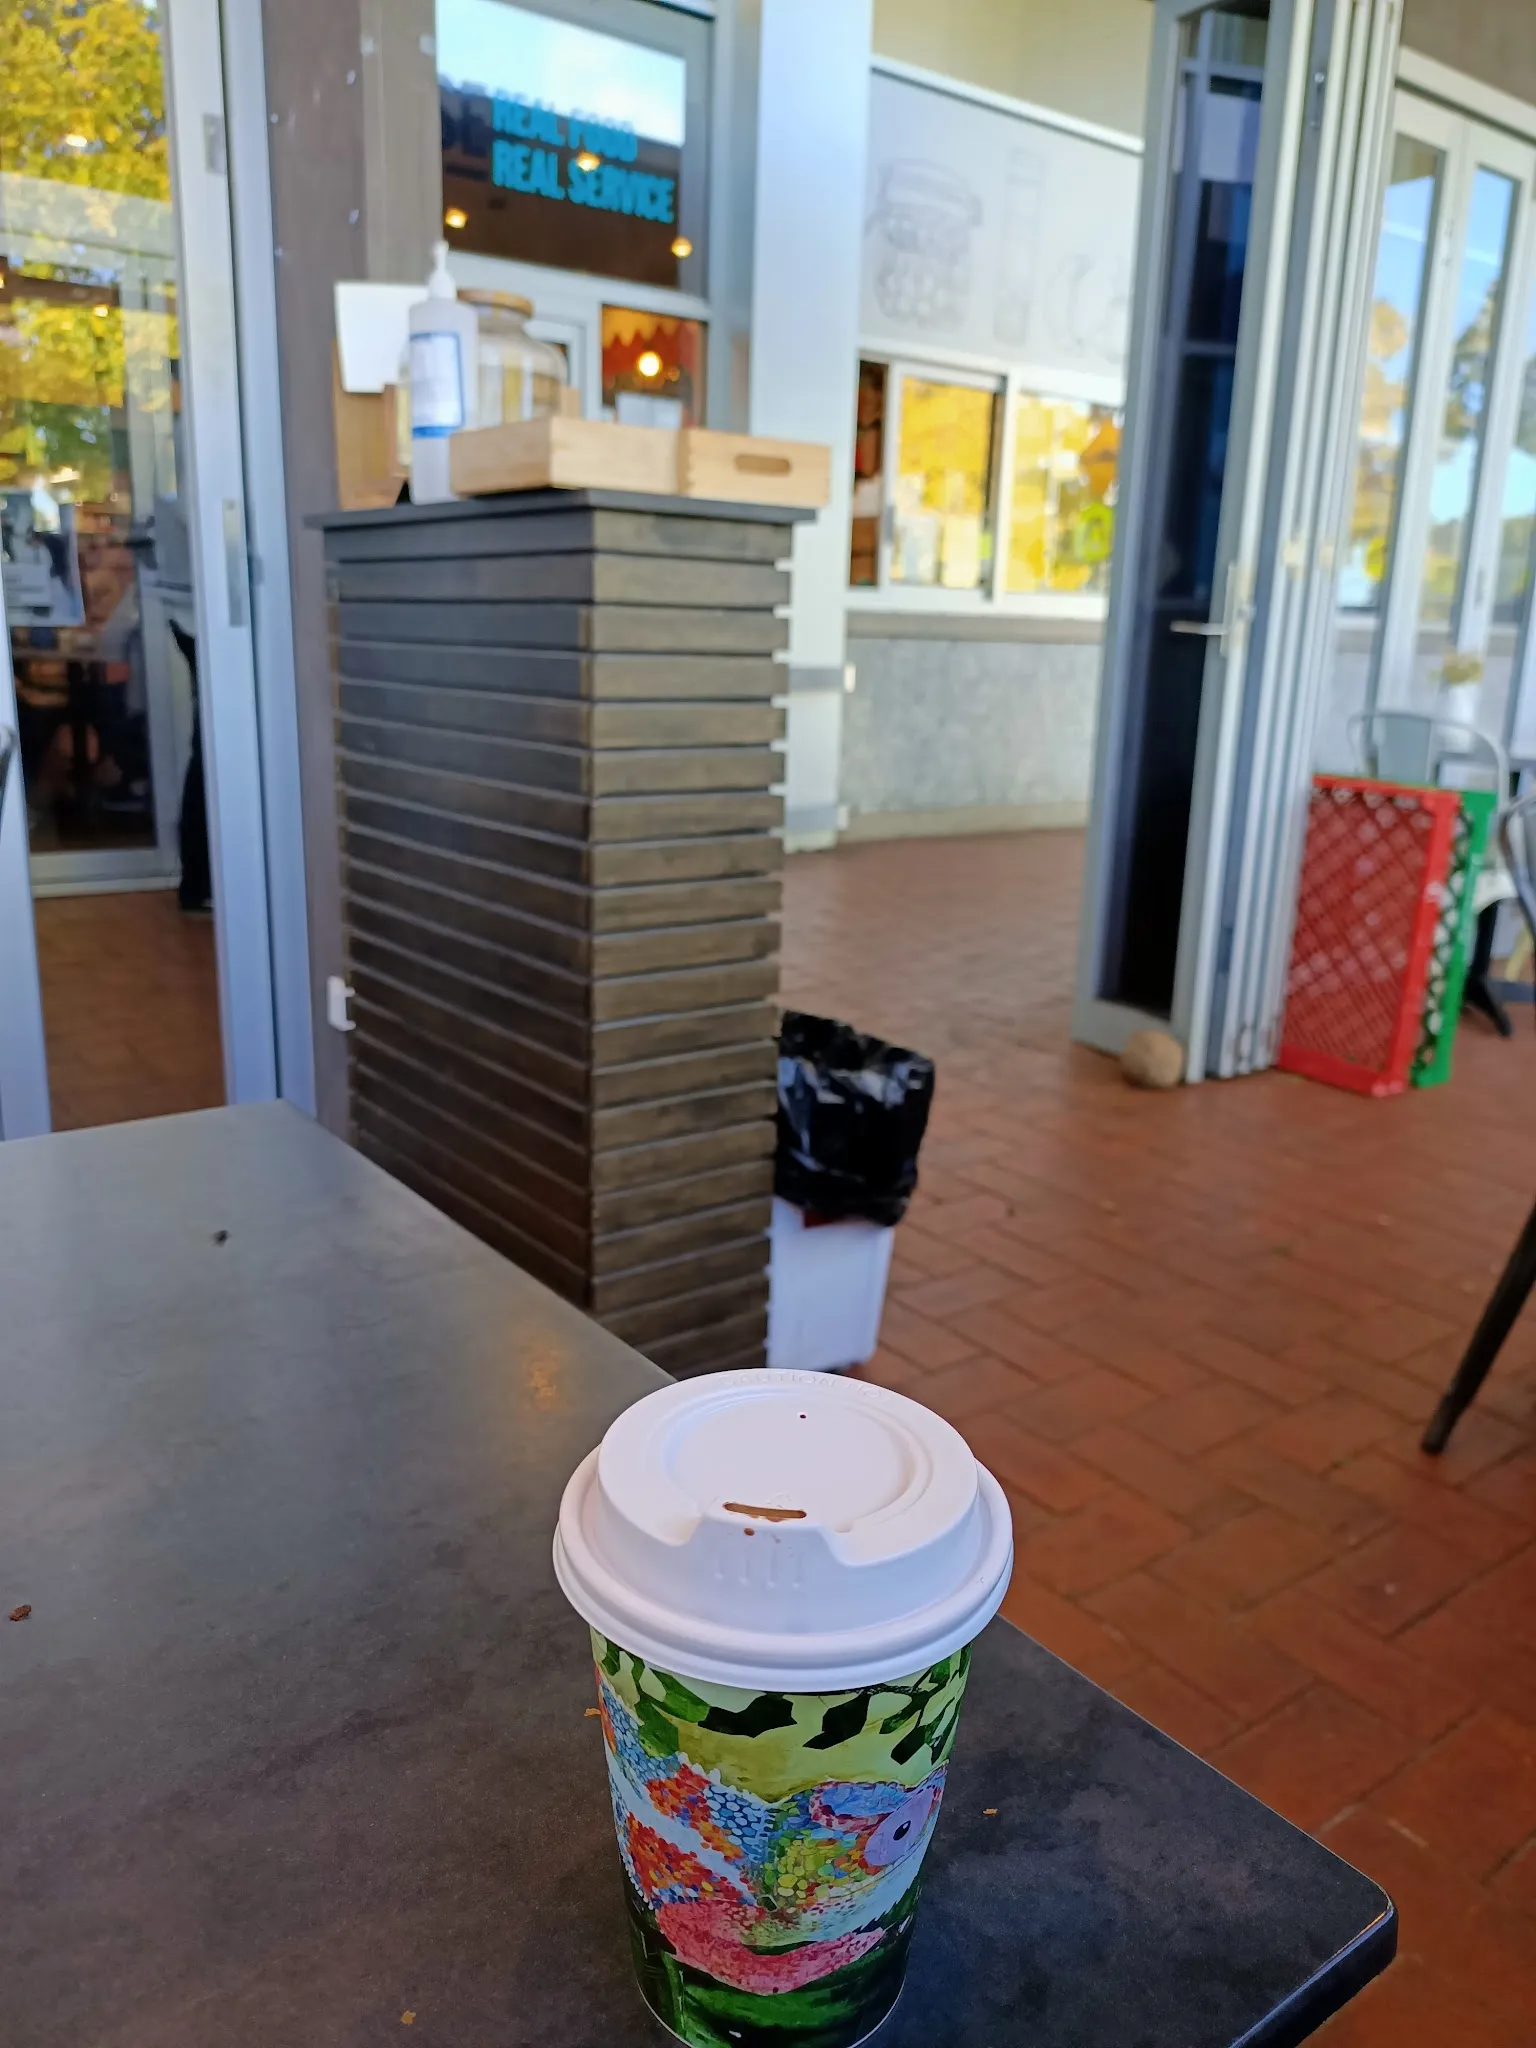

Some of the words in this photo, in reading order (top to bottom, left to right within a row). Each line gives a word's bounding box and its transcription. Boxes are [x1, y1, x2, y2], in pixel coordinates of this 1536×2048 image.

[492, 92, 566, 147] REAL
[492, 139, 566, 200] REAL
[567, 160, 675, 224] SERVICE
[718, 1370, 837, 1388] CAUTION
